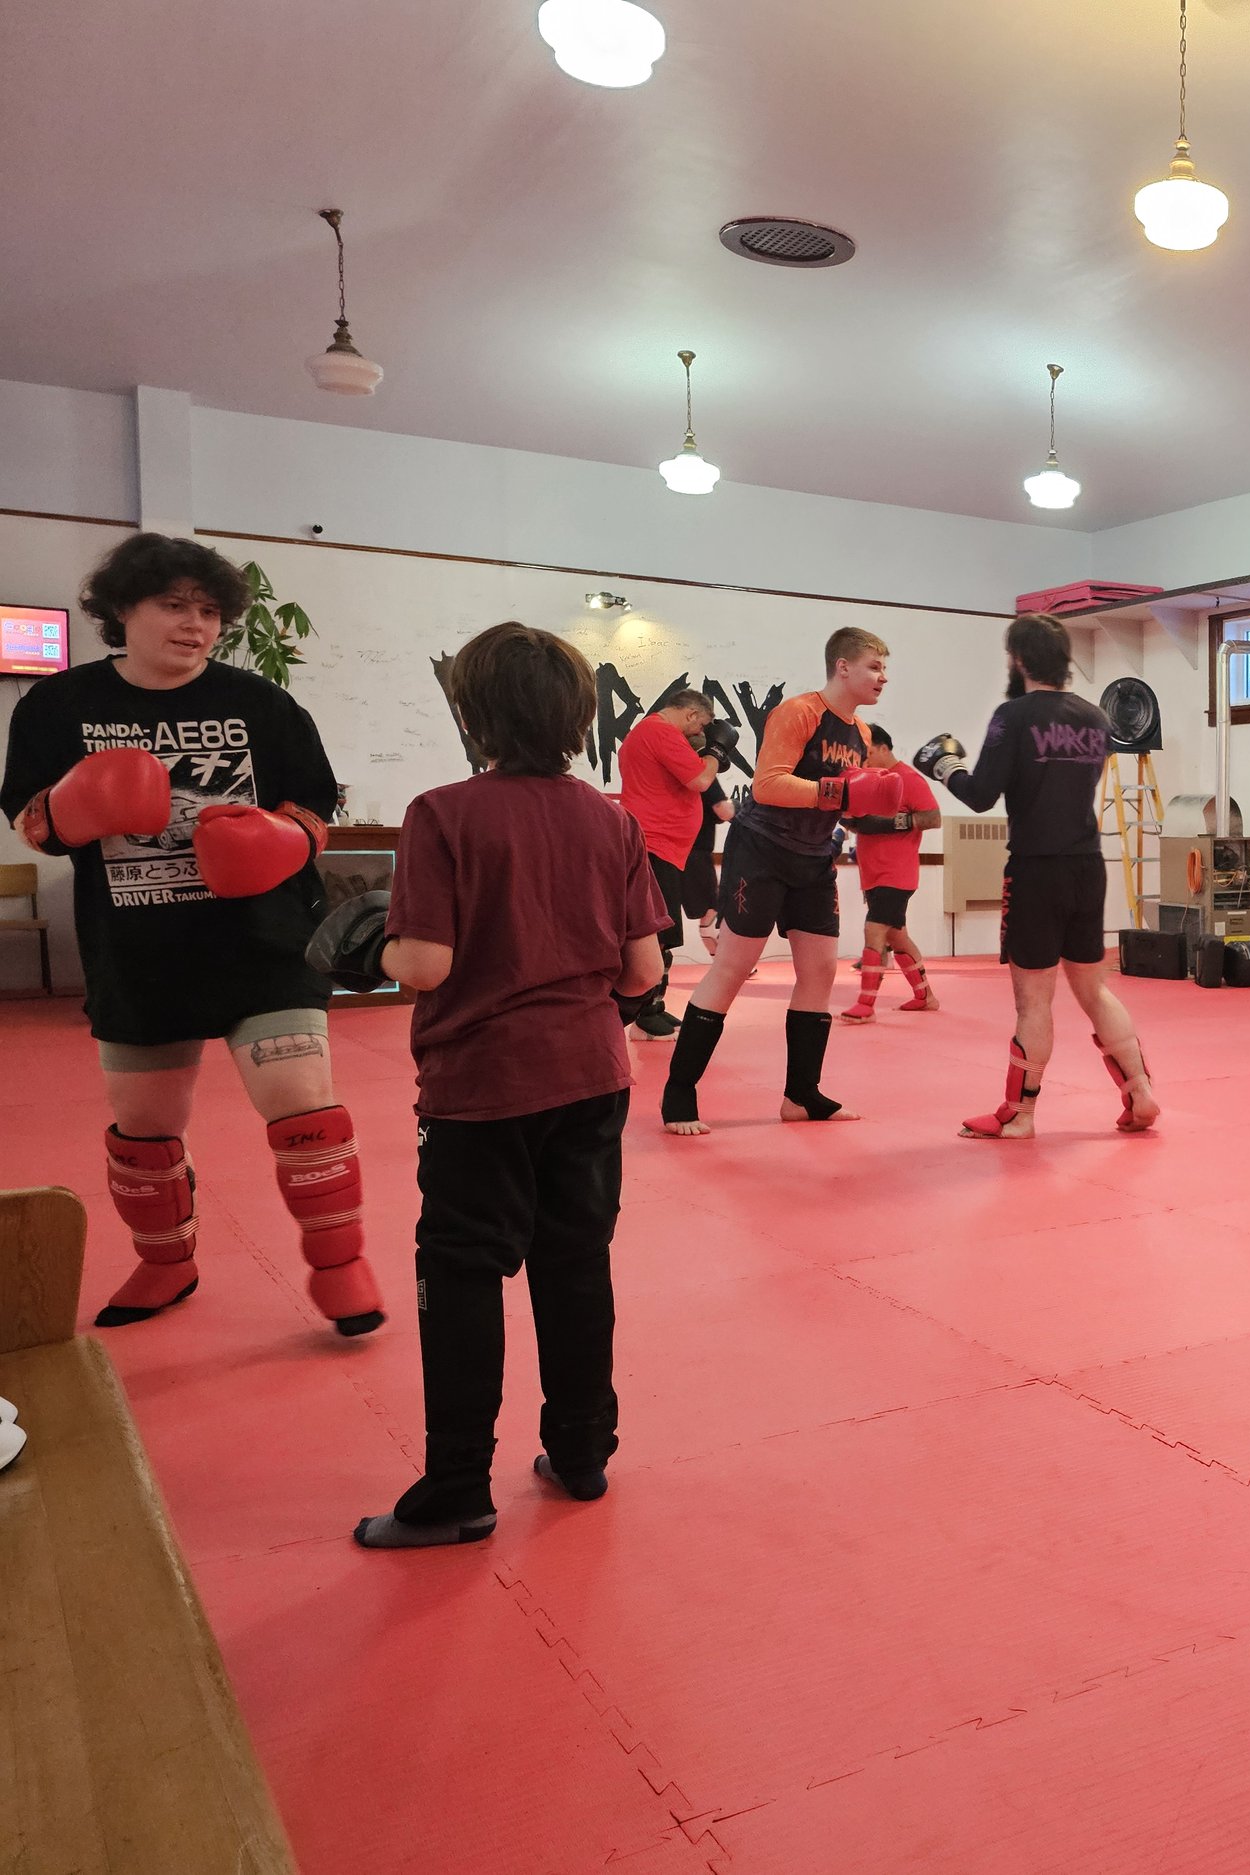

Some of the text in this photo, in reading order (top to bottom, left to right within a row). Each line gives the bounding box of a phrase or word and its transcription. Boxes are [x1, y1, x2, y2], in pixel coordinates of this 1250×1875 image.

[82, 722, 151, 738] PANDA-
[154, 718, 249, 751] AE86
[111, 889, 174, 907] DRIVER
